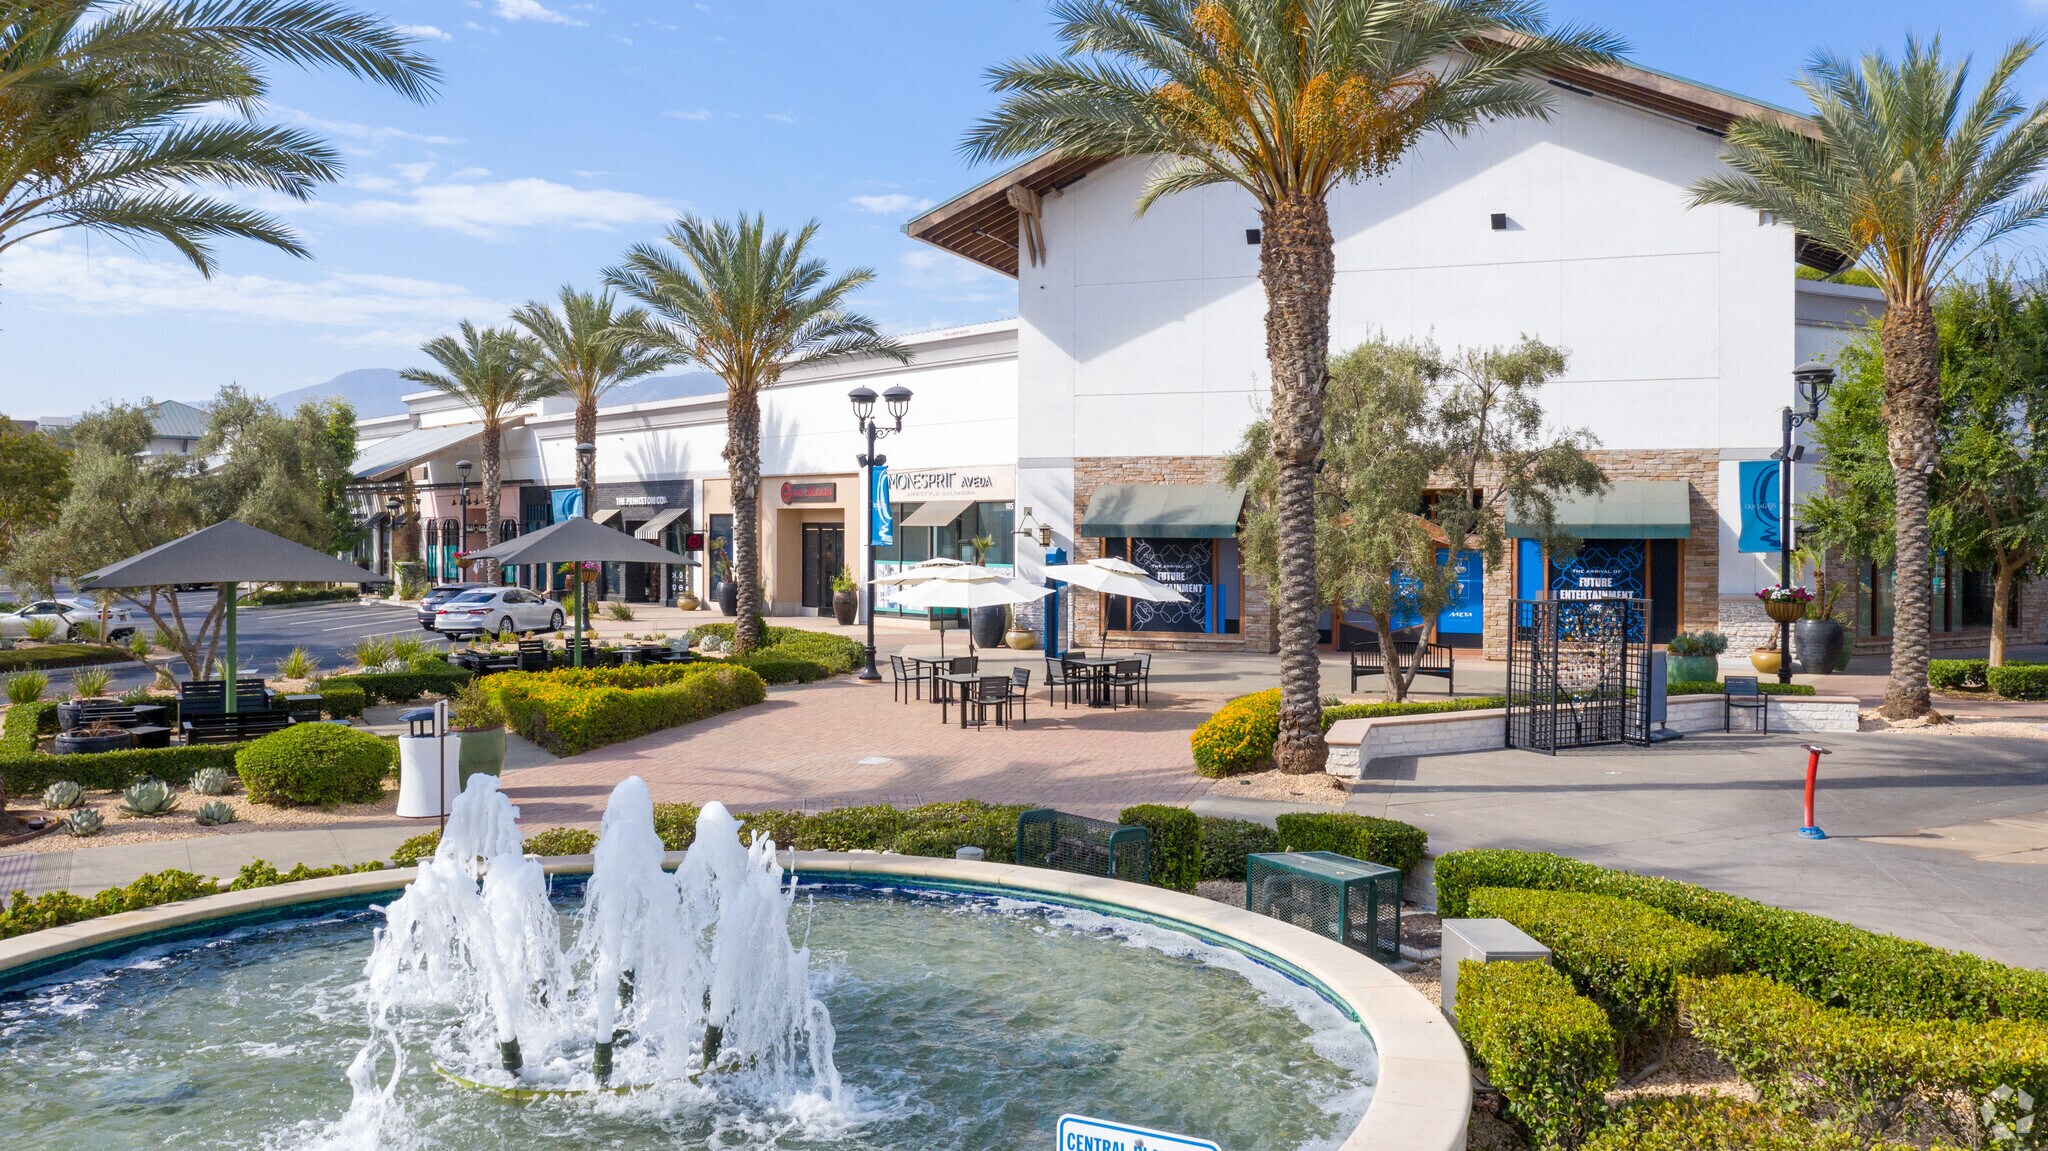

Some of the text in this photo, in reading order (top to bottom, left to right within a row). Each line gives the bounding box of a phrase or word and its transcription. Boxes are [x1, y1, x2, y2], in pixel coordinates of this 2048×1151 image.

[961, 475, 993, 488] AVEDA
[616, 497, 626, 505] THE
[626, 496, 657, 505] PRINCETON
[1005, 502, 1014, 510] 105
[1157, 571, 1186, 581] FUTURE
[1579, 577, 1613, 587] FUTURE
[1559, 589, 1634, 600] ENTERTAINMENT
